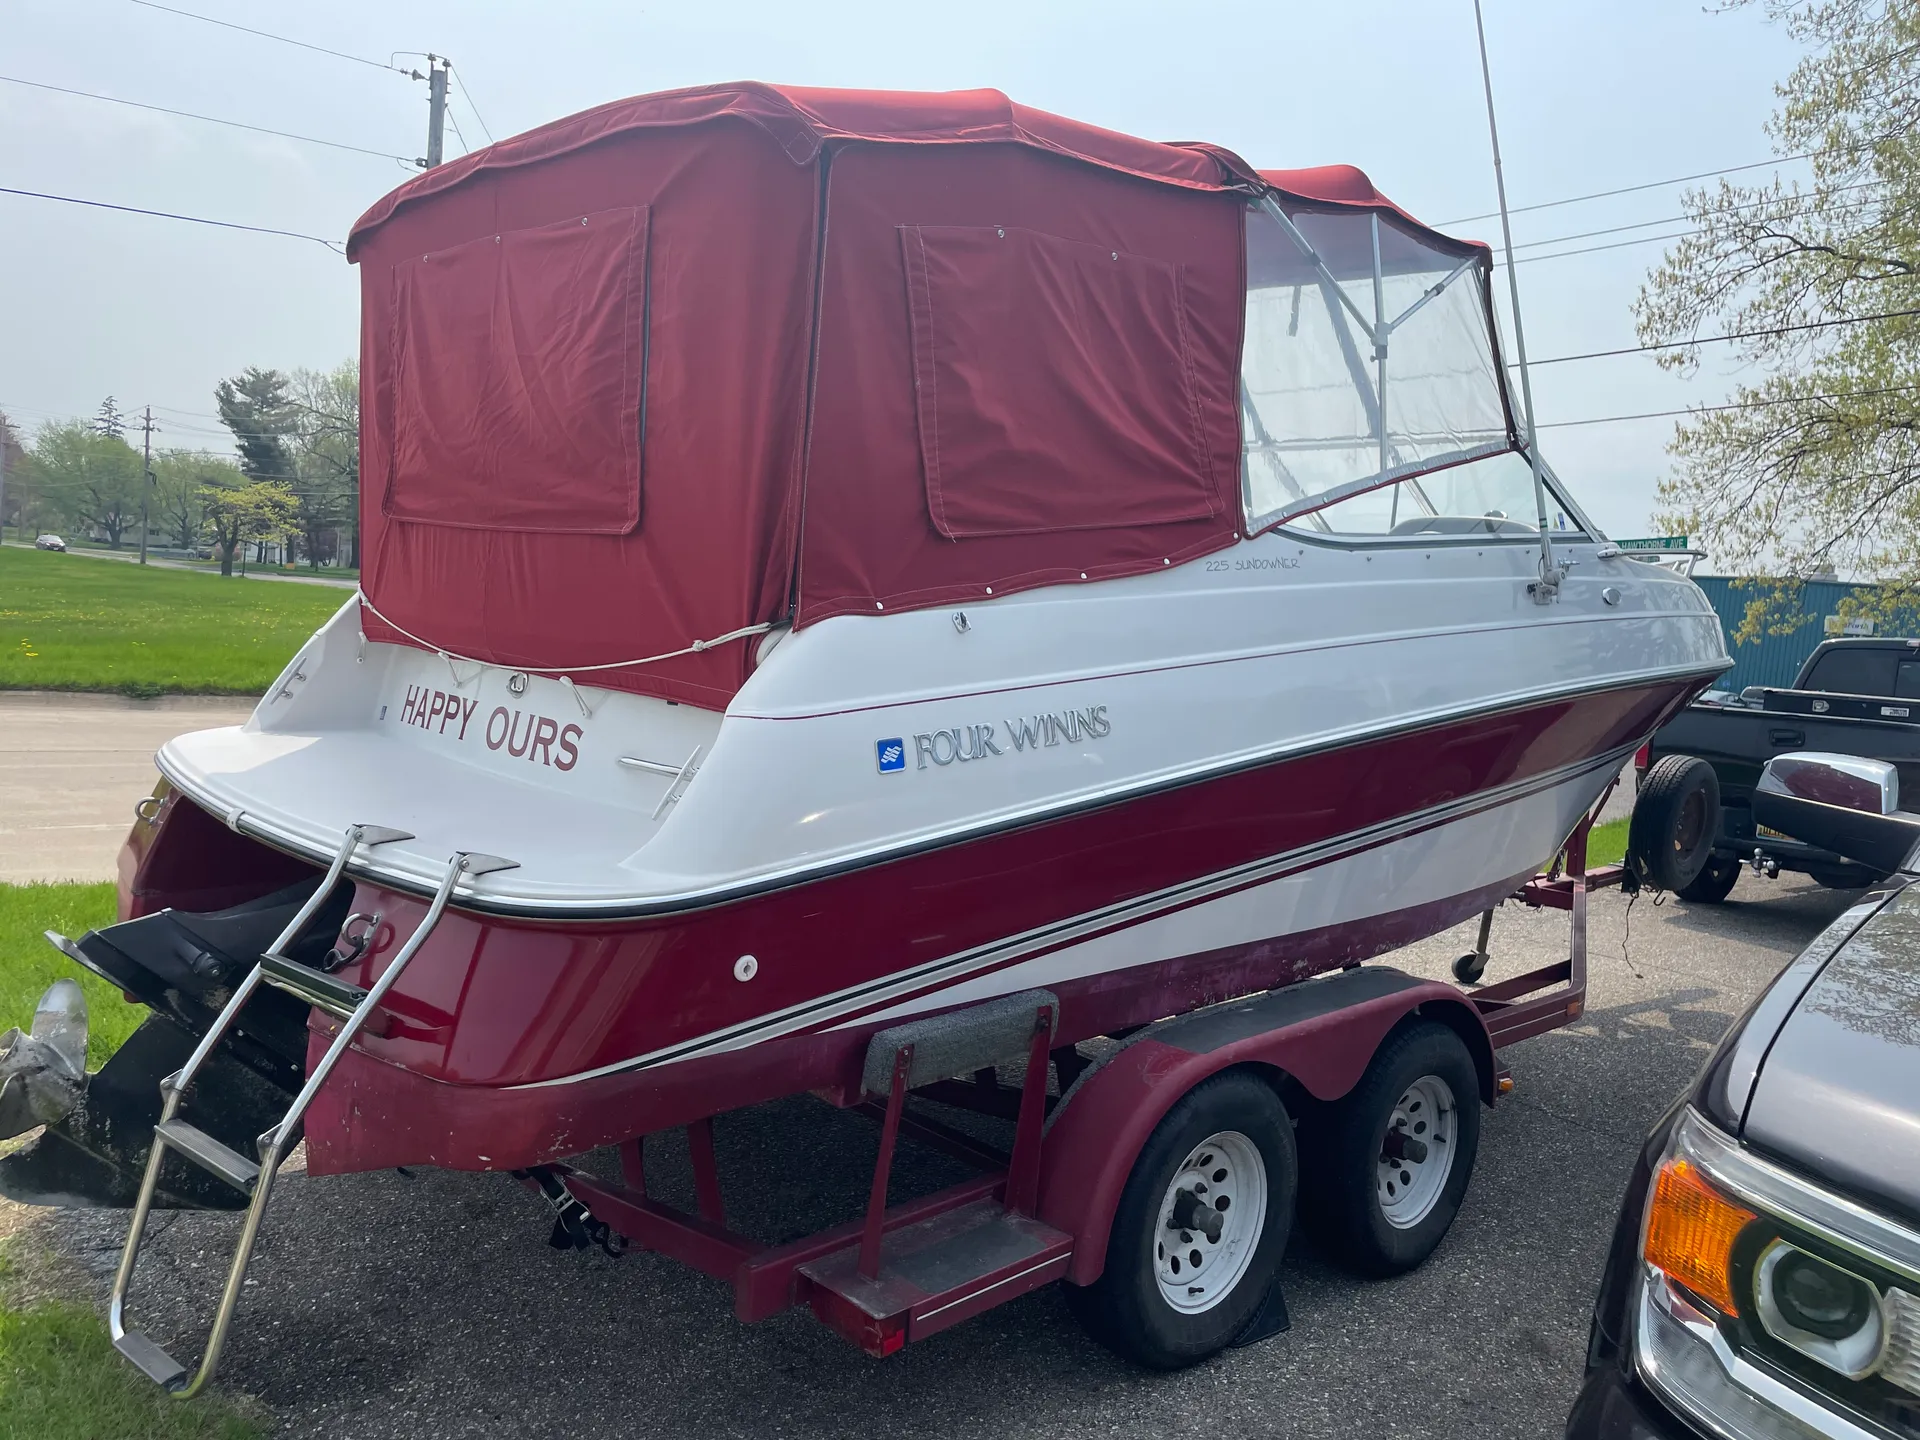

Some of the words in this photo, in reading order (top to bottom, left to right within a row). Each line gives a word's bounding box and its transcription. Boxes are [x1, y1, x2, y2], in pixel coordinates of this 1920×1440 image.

[1205, 560, 1230, 572] 225
[1235, 557, 1300, 571] SUNDOWNER
[1621, 541, 1666, 549] HAWTHORNE
[1670, 539, 1684, 549] AVE
[400, 684, 478, 740] HAPPY
[486, 706, 584, 771] OURS
[913, 722, 1003, 770] FOUR
[1004, 703, 1111, 751] WINNS
